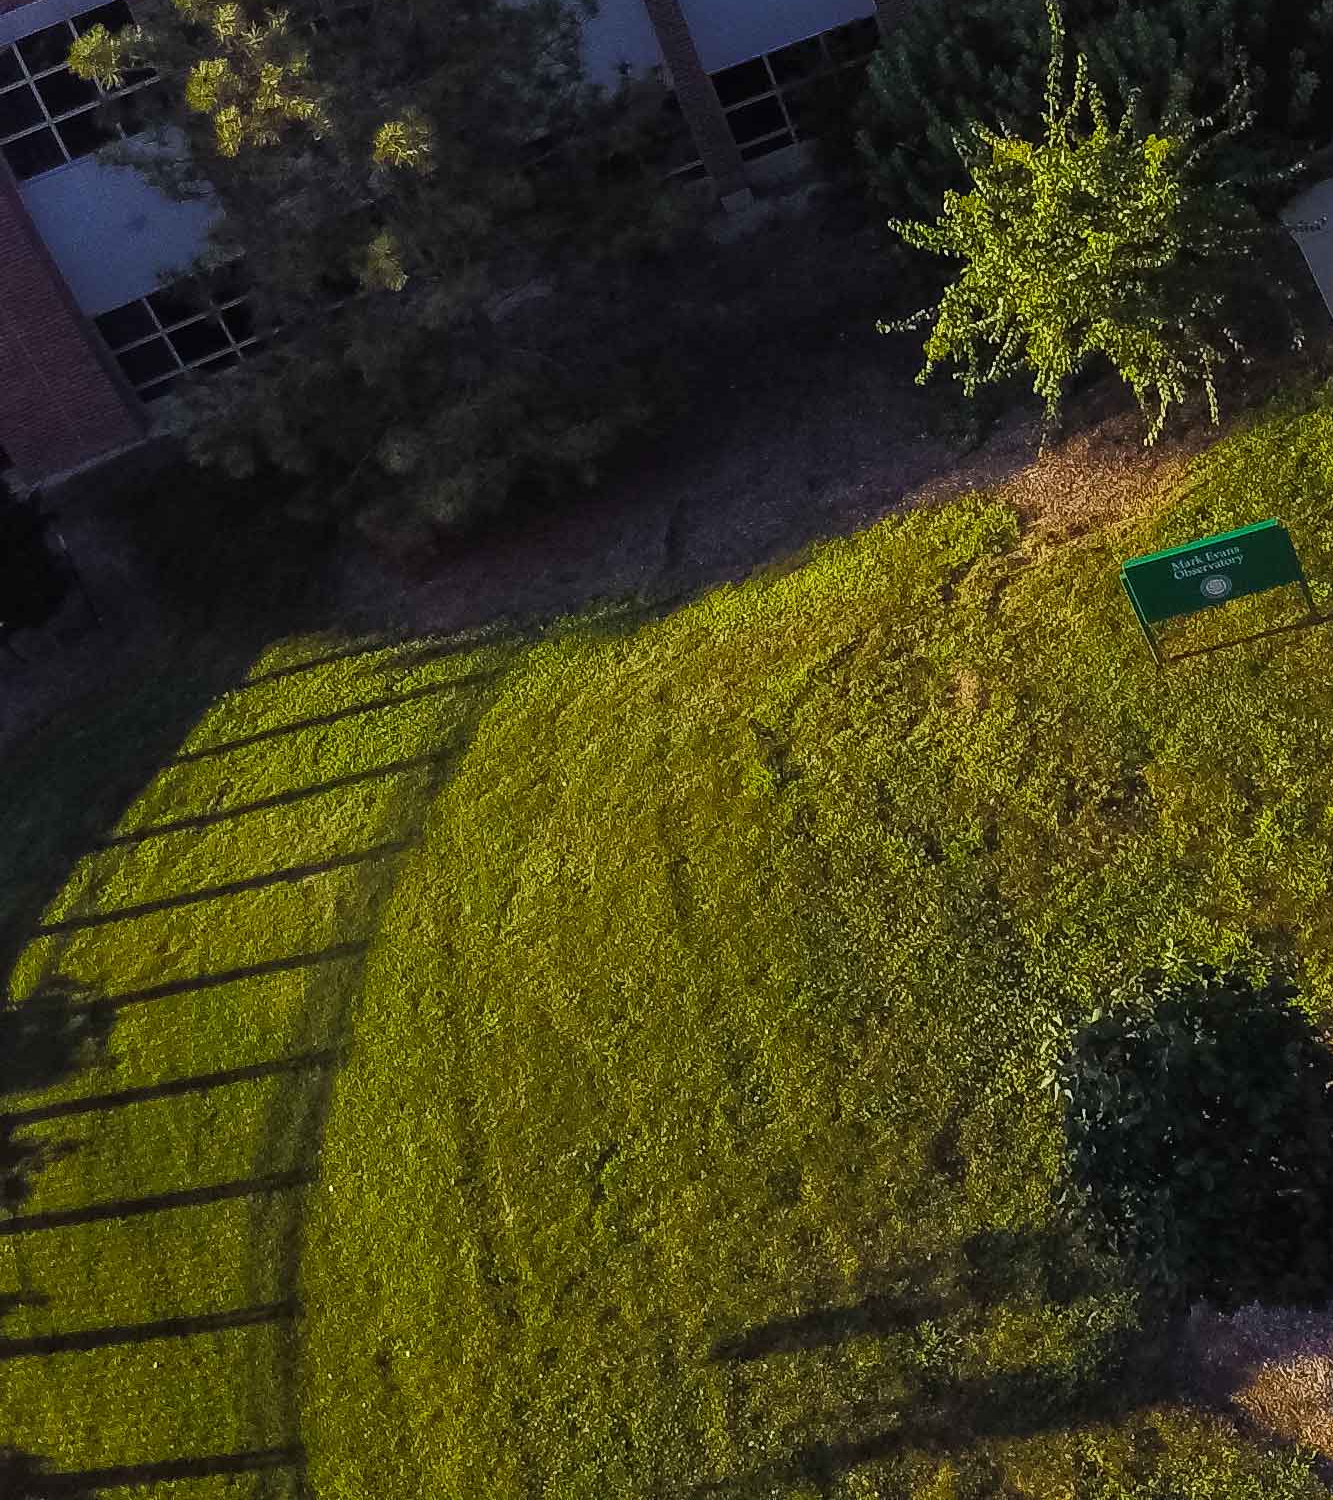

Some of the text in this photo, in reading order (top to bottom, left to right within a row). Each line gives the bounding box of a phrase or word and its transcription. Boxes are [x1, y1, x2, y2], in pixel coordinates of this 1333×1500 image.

[1171, 546, 1240, 572] Mark Evans
[1173, 554, 1244, 580] Observatory
